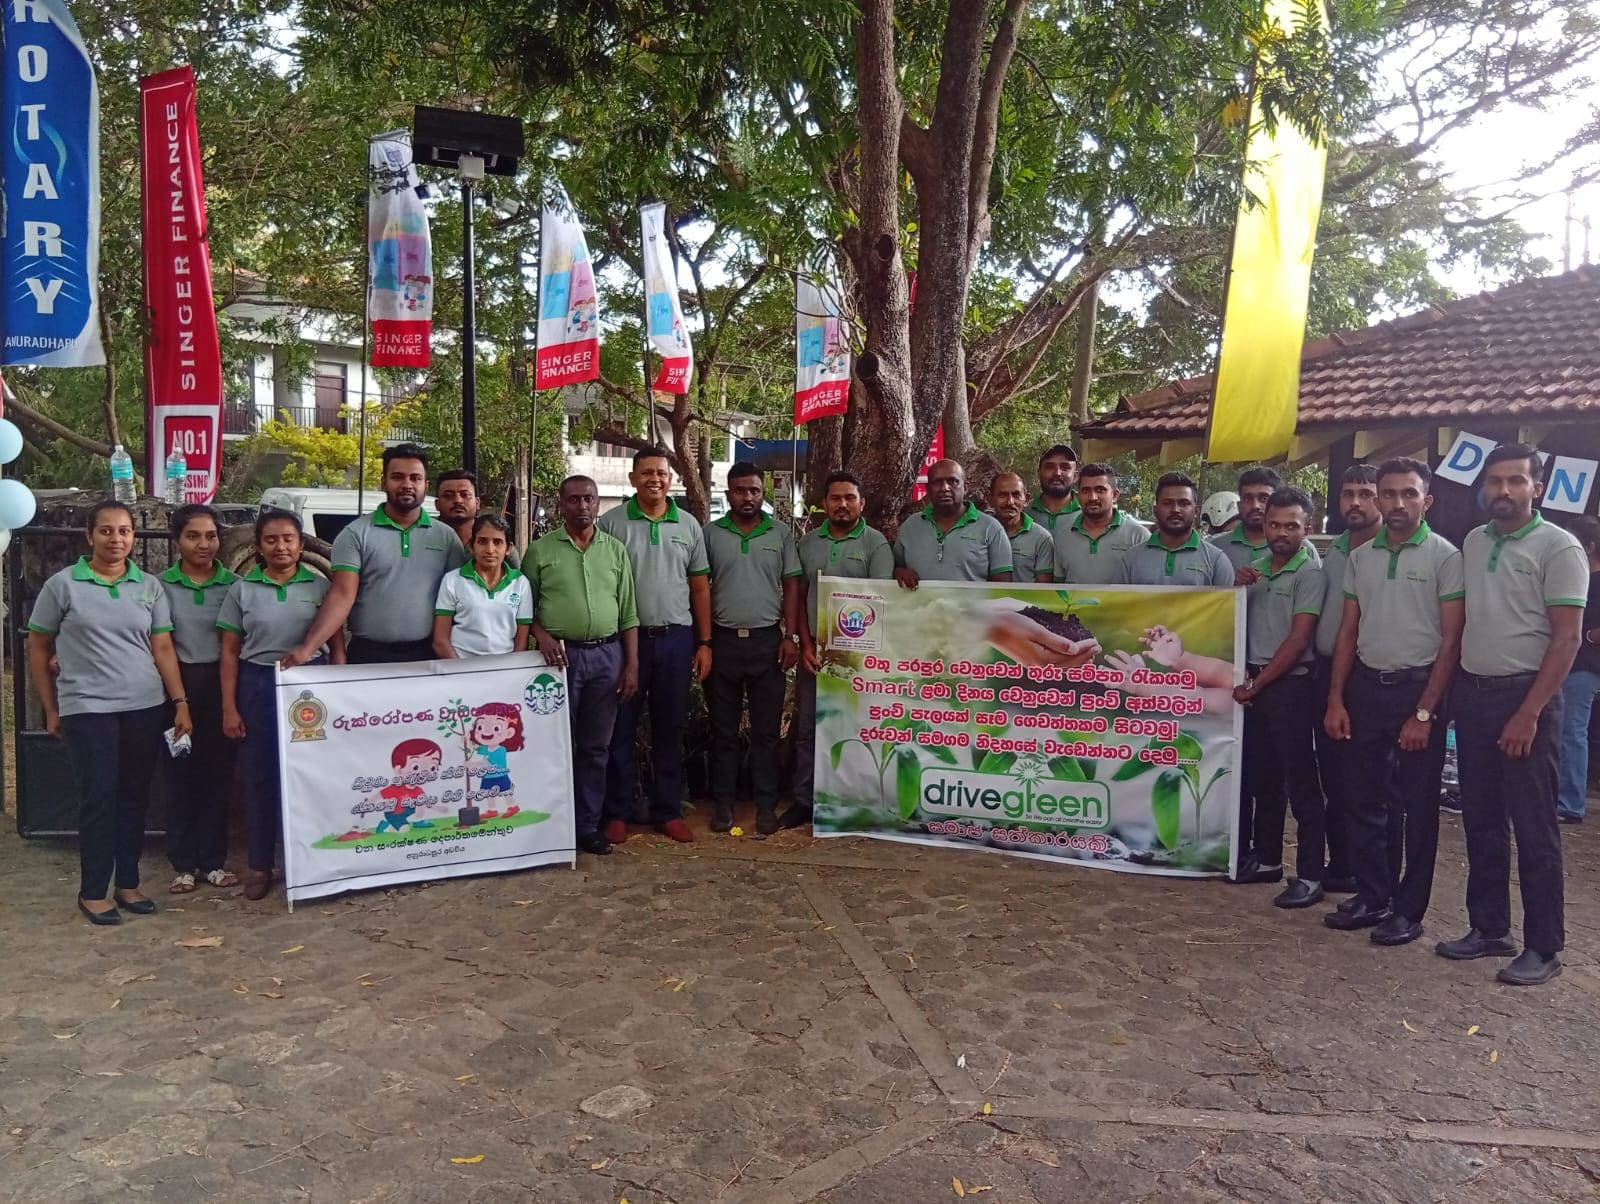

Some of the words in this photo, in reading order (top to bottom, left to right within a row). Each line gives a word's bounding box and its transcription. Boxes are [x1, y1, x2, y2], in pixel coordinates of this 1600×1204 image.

[166, 102, 188, 241] FINANCE
[174, 256, 196, 390] SINGER
[376, 333, 422, 344] SINGER
[376, 344, 422, 355] FINANCE
[541, 351, 592, 369] SINGER
[542, 362, 592, 380] FINANCE
[801, 397, 842, 416] FINANCE
[802, 389, 842, 408] SINGER
[171, 429, 207, 455] NO.1
[1447, 440, 1483, 472] D
[1547, 468, 1587, 503] N
[864, 655, 890, 673] මතු
[897, 658, 944, 676] පරපුර
[949, 660, 1022, 679] වෙනුවෙන්
[1029, 665, 1062, 683] තුරු
[1068, 664, 1124, 684] සම්පත
[1131, 669, 1197, 690] රැකගමු
[852, 677, 915, 697] Smart
[920, 682, 951, 699] ළමා
[956, 683, 994, 702] දිනය
[1000, 686, 1075, 708] වෙනුවෙන්
[1080, 690, 1120, 711] පුංචි
[1126, 695, 1203, 716] අත්වලින්
[869, 703, 904, 720] පුංචි
[910, 707, 969, 724] පැලයක්
[975, 711, 1008, 725] සෑම
[1014, 713, 1107, 733] ගෙවත්තකම
[1114, 718, 1178, 741] සිටවමු!
[860, 727, 912, 744] දරුවන්
[917, 731, 970, 747] සමගම
[976, 733, 1037, 753] නිදහසේ
[1044, 740, 1132, 761] වැඩෙන්නට
[924, 778, 1102, 819] drivegreen
[355, 844, 374, 854] වන
[991, 825, 1108, 853] සත්කාරයකි
